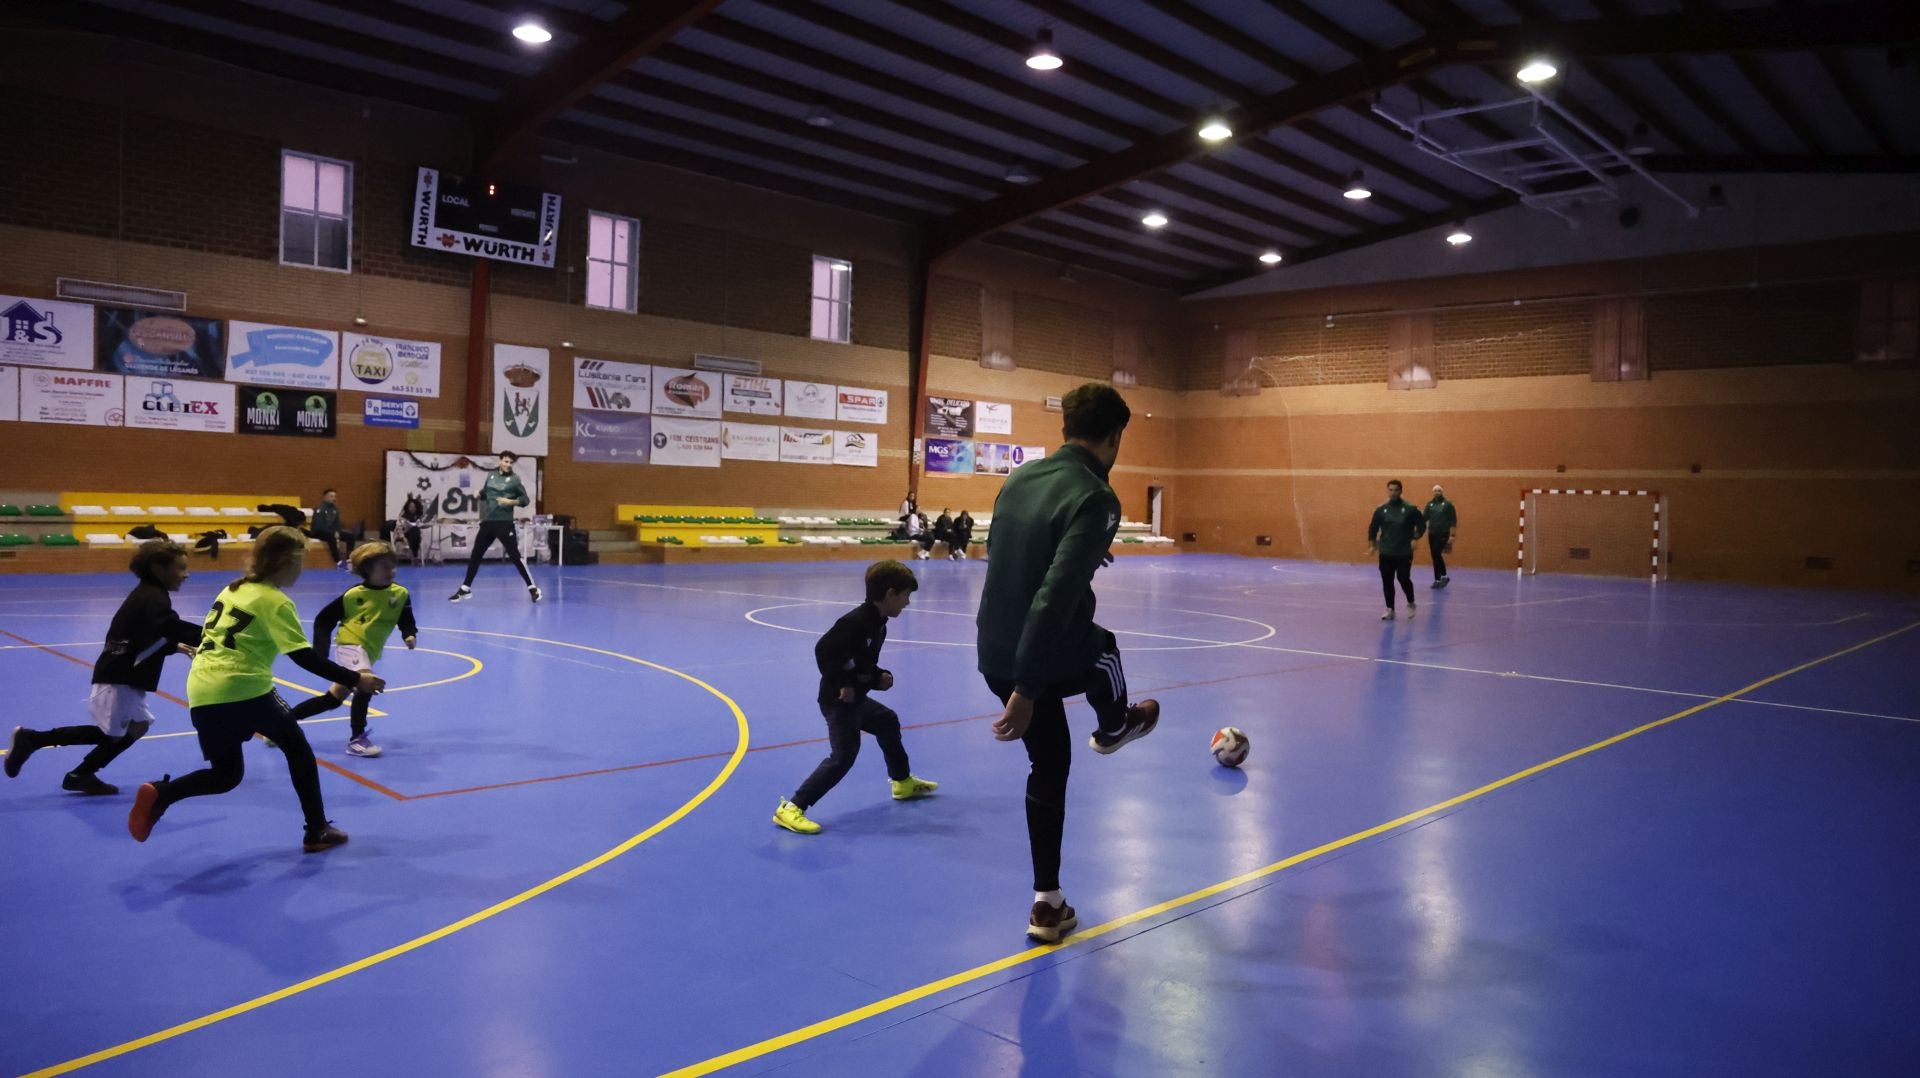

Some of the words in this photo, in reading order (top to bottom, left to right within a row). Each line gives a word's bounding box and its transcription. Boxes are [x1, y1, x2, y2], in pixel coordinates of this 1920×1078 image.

[442, 194, 470, 208] LOCAL
[463, 236, 536, 262] WÜRTH
[356, 364, 386, 377] TAXI
[578, 369, 621, 382] Lusitania
[625, 374, 646, 383] Cars
[53, 376, 112, 388] MAPFRE
[733, 376, 771, 391] STIHL
[847, 395, 876, 406] SPAR
[928, 445, 949, 455] MGS
[197, 600, 254, 655] 27
